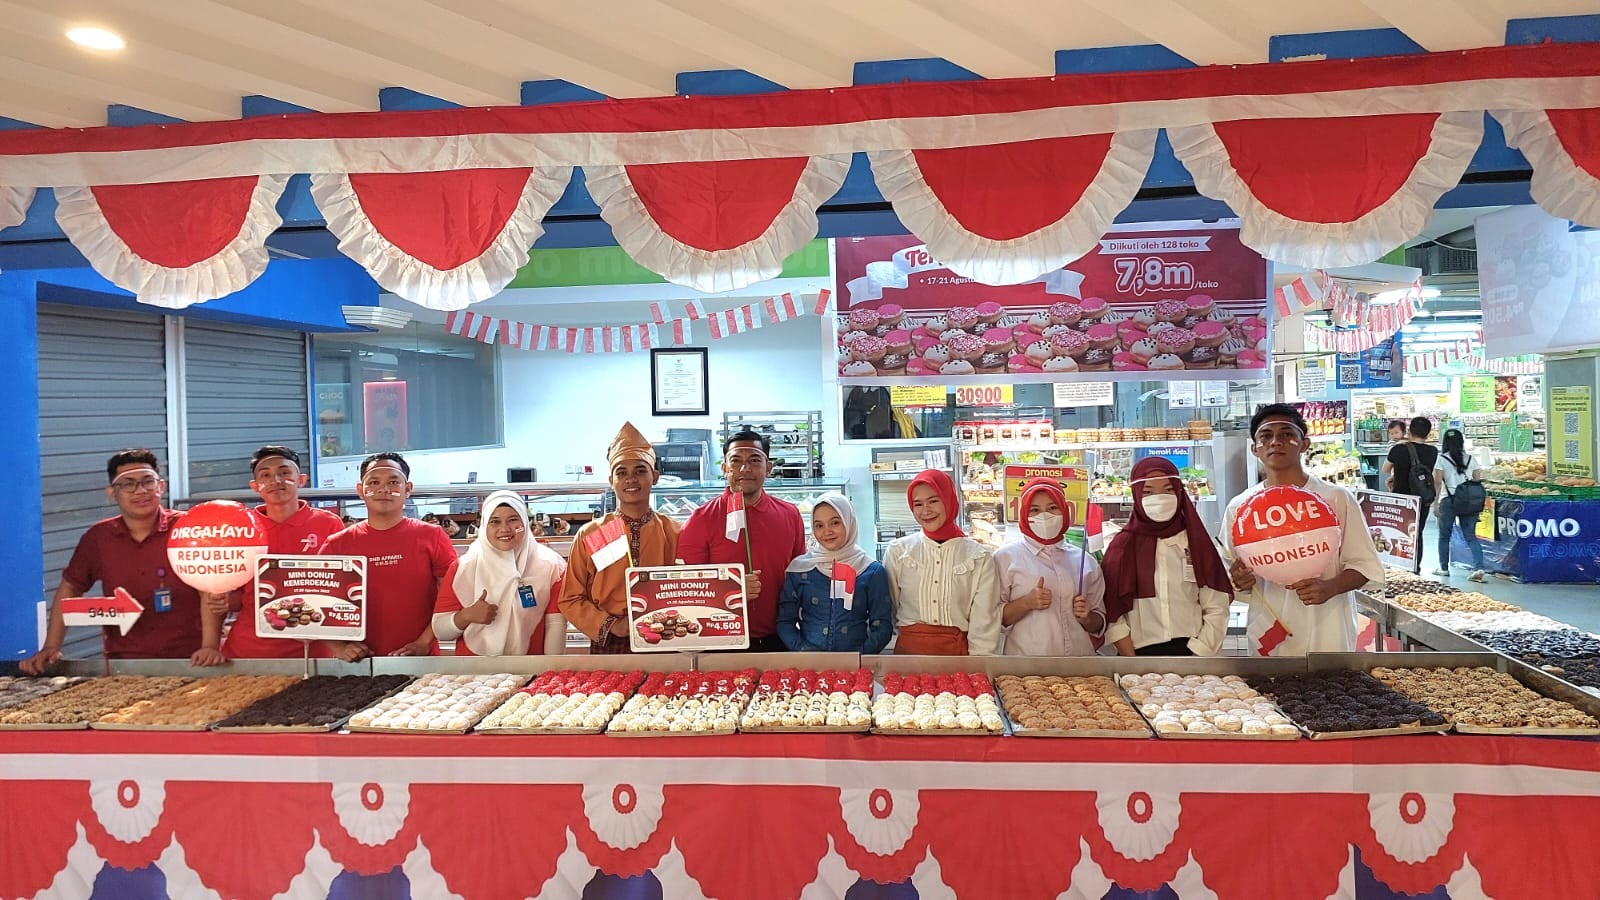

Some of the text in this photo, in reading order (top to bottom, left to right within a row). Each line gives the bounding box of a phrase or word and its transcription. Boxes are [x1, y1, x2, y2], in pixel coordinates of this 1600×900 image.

[1109, 239, 1199, 251] Diikuti oleh 128 toko
[1116, 258, 1192, 291] 7,8m
[957, 386, 1002, 404] 30900
[1024, 468, 1063, 477] promosi
[1253, 500, 1321, 530] LOVE
[170, 524, 255, 540] DIRGAHAYU
[1497, 516, 1580, 538] PROMO
[177, 549, 245, 561] REPUBLIK
[1248, 542, 1331, 567] INDONESIA
[175, 563, 247, 575] INDONESIA
[288, 571, 335, 580] MINI DONUT
[283, 579, 340, 588] KEMERDEKAAN
[659, 583, 679, 591] MINI
[655, 590, 716, 599] KEMERDEKAAN
